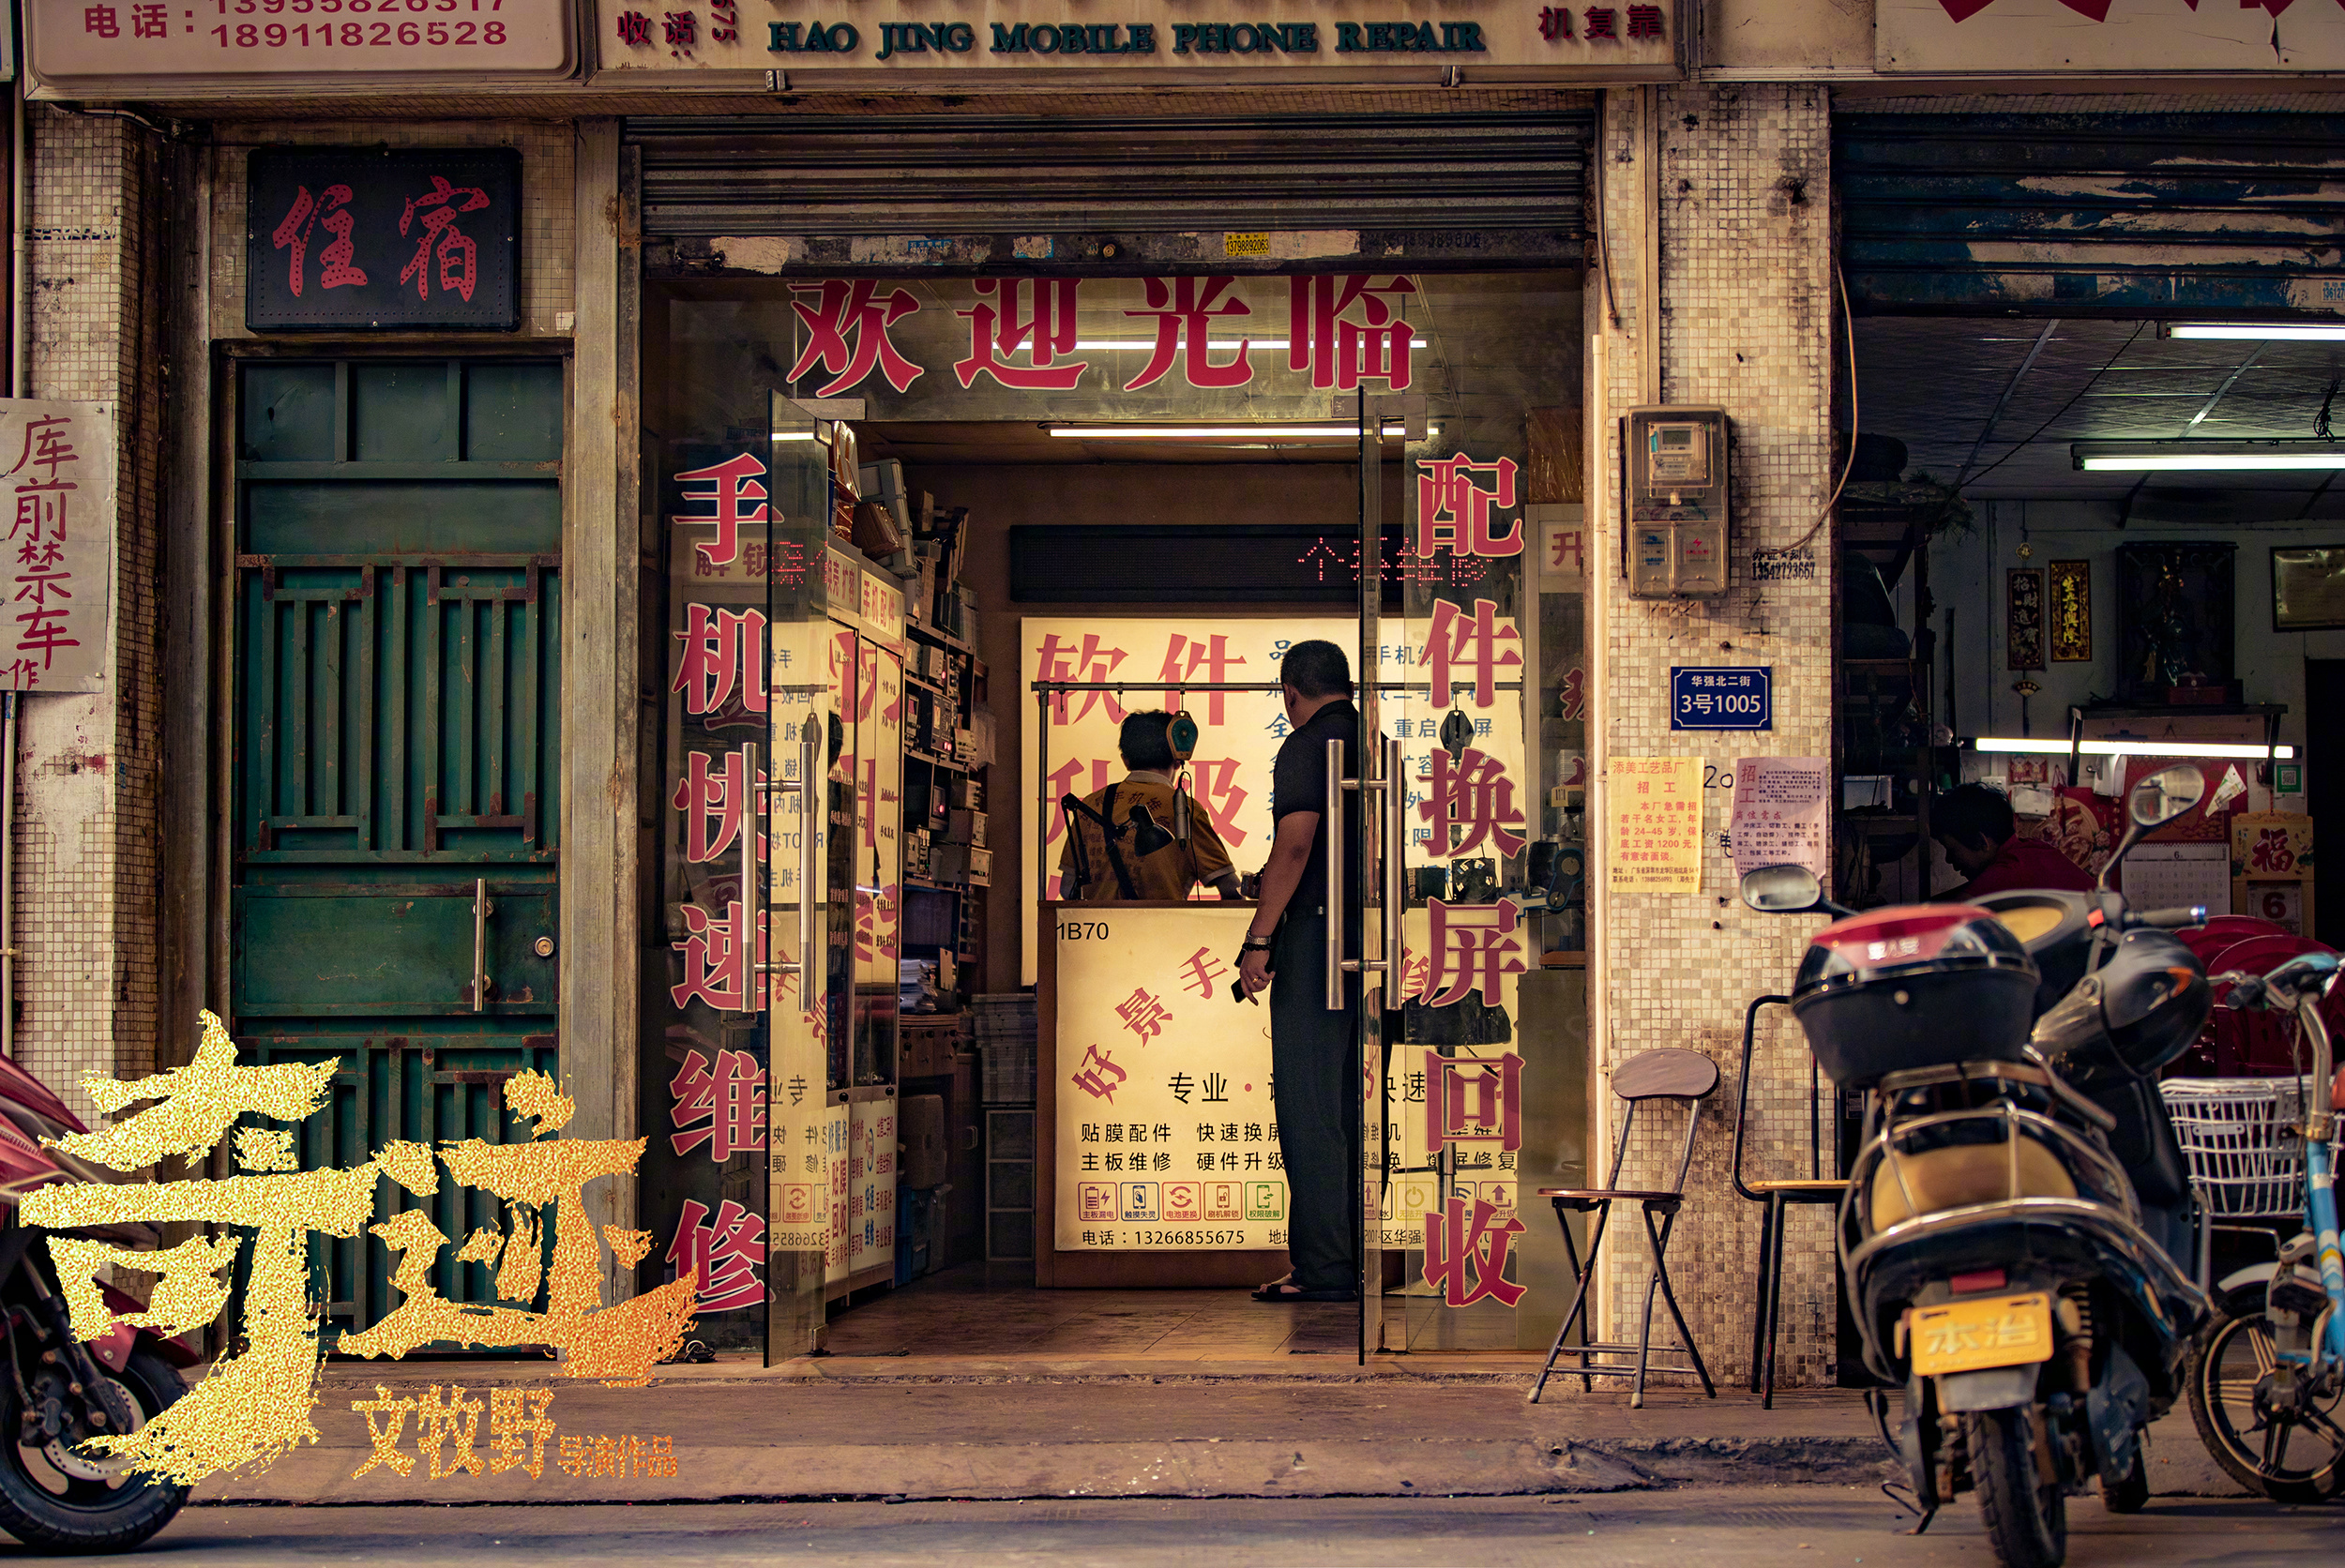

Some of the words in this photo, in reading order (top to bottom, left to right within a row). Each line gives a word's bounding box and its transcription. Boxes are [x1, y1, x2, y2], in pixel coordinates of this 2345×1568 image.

[210, 21, 508, 48] 18911826528
[616, 10, 652, 45] 收
[1537, 6, 1573, 40] 机
[1626, 4, 1662, 38] 靠
[766, 21, 858, 53] HAO
[875, 22, 975, 60] JING
[989, 23, 1156, 54] MOBILE
[1171, 23, 1318, 53] PHONE
[1334, 21, 1487, 53] REPAIR
[272, 174, 492, 301] 住宿
[786, 275, 1417, 399] 欢迎光临
[1036, 633, 1249, 726] 软件
[1691, 675, 1751, 687] 华强北二街
[1681, 695, 1762, 715] 3号1005
[1613, 761, 1685, 775] 添美工艺品厂
[1739, 764, 1757, 803] 招工
[2251, 828, 2295, 872] 福
[665, 451, 786, 1314] 手机快速维修
[1415, 457, 1529, 1309] 配件换屏回收
[2262, 892, 2287, 919] 6
[1055, 922, 1109, 941] 1B70
[1082, 1123, 1172, 1142] 贴膜配件
[1082, 1153, 1172, 1171] 主板维修
[1197, 1153, 1286, 1171] 硬件升级
[1082, 1210, 1115, 1219] 主板漏电
[1166, 1210, 1198, 1219] 电池更换
[1207, 1210, 1239, 1219] 刷机解锁
[1248, 1210, 1280, 1218] 权限破解
